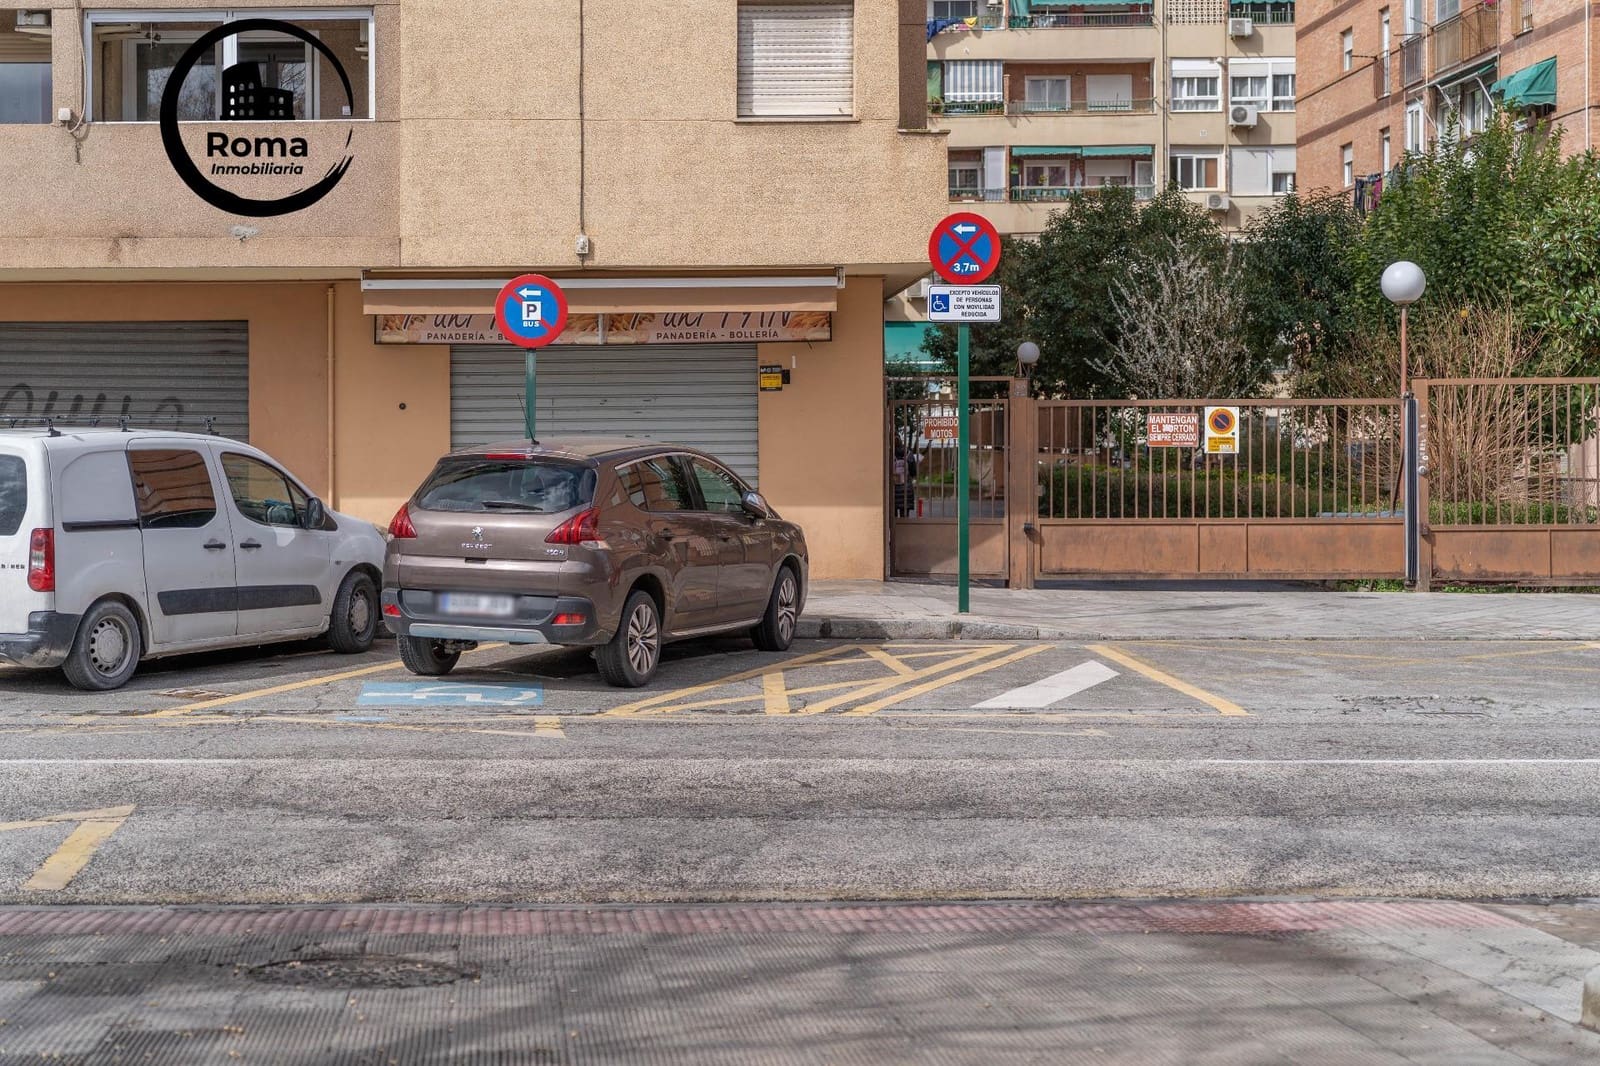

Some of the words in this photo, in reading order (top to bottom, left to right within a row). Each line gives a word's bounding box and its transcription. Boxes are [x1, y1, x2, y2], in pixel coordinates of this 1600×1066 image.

[953, 262, 979, 273] 3,7m
[526, 304, 538, 318] P
[522, 320, 540, 328] BUS
[427, 331, 485, 341] PANADERÍA
[656, 330, 717, 340] PANADERÍA
[729, 328, 779, 339] BOLLERÍA
[924, 418, 959, 427] PROHIBIDO
[1149, 415, 1197, 424] MANTENGAN
[1151, 424, 1162, 433] EL
[931, 429, 953, 438] MOTOS
[1171, 433, 1197, 442] CERRADO
